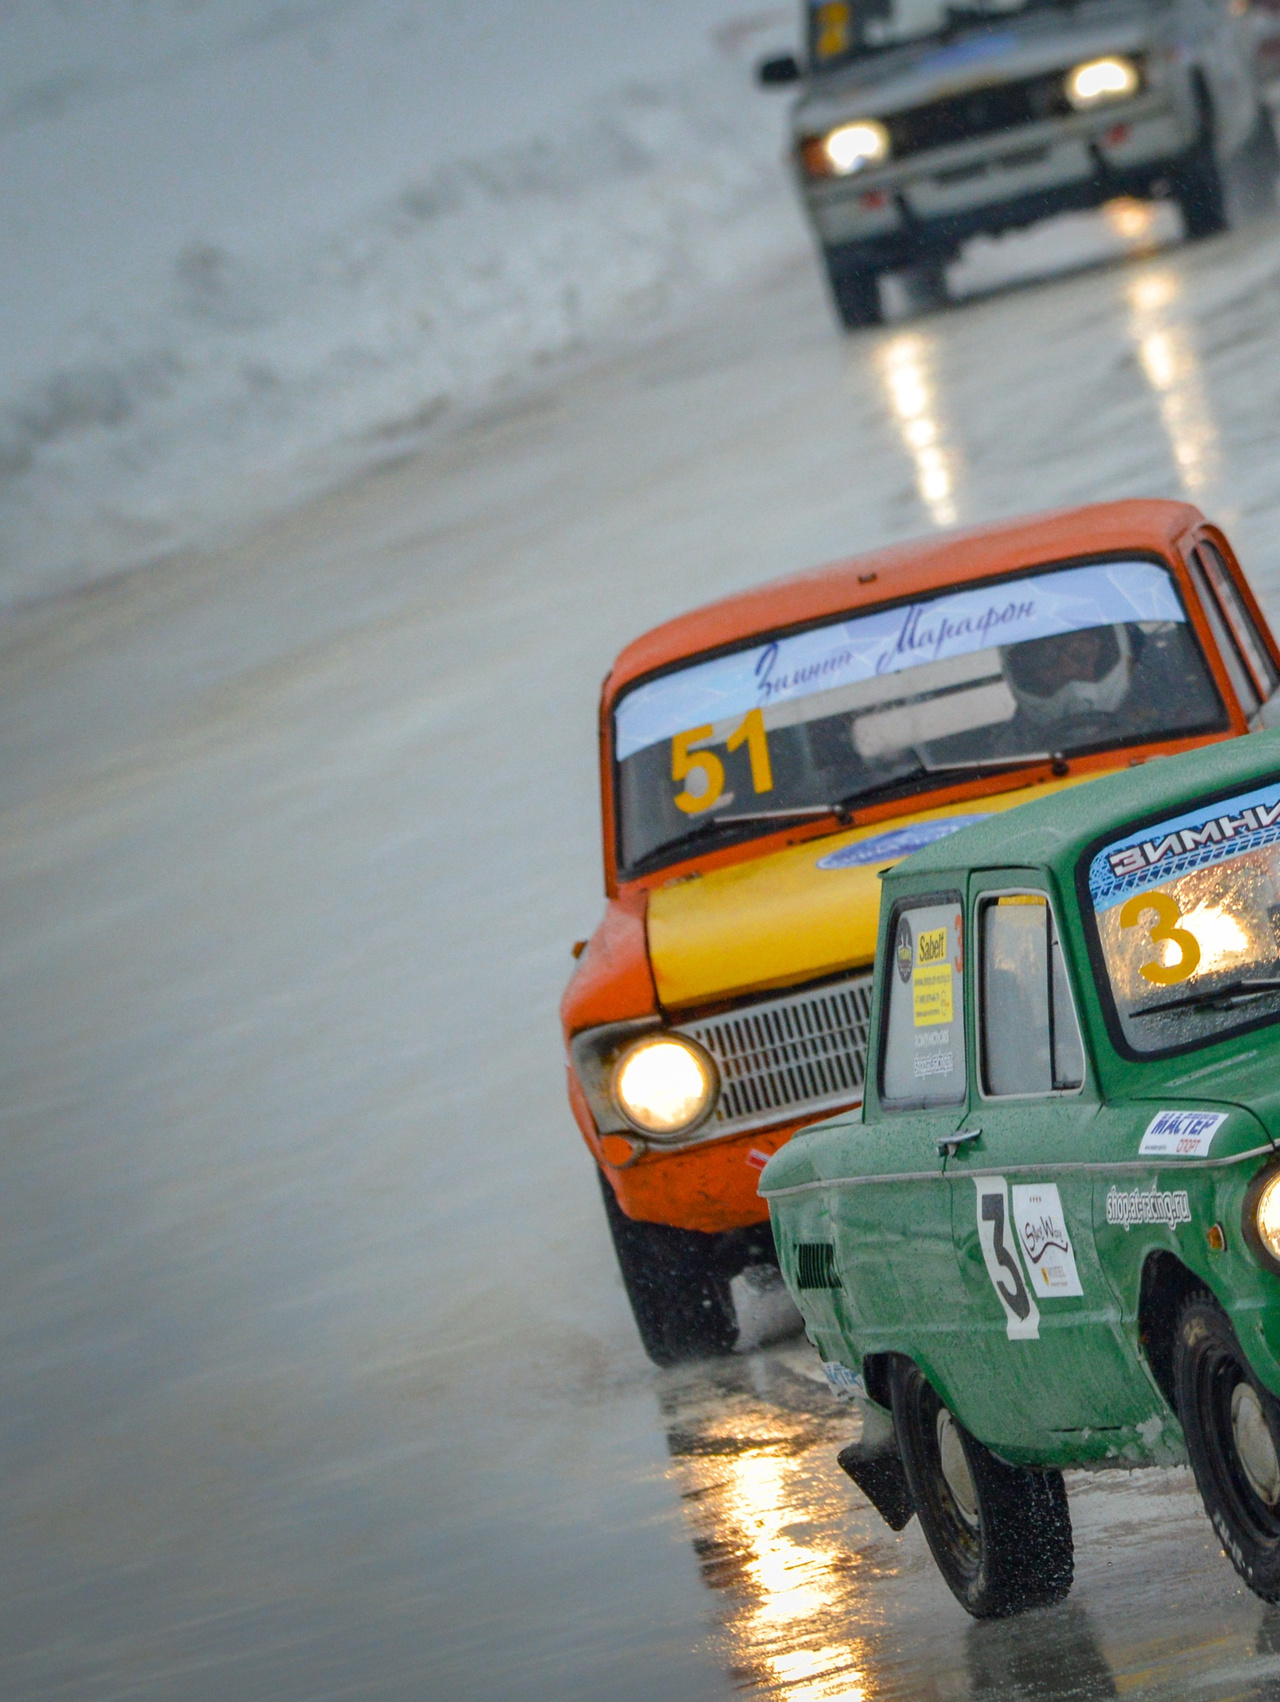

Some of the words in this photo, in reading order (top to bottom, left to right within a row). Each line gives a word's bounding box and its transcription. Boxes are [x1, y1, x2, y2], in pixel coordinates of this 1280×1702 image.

[754, 641, 853, 705] Зимний
[875, 600, 1036, 674] Марафон
[671, 707, 774, 814] 51
[1119, 891, 1201, 986] 3
[1150, 1112, 1221, 1136] МАСТЕР
[981, 1193, 1031, 1322] 3
[1106, 1184, 1191, 1231] shop.at-racing.ru
